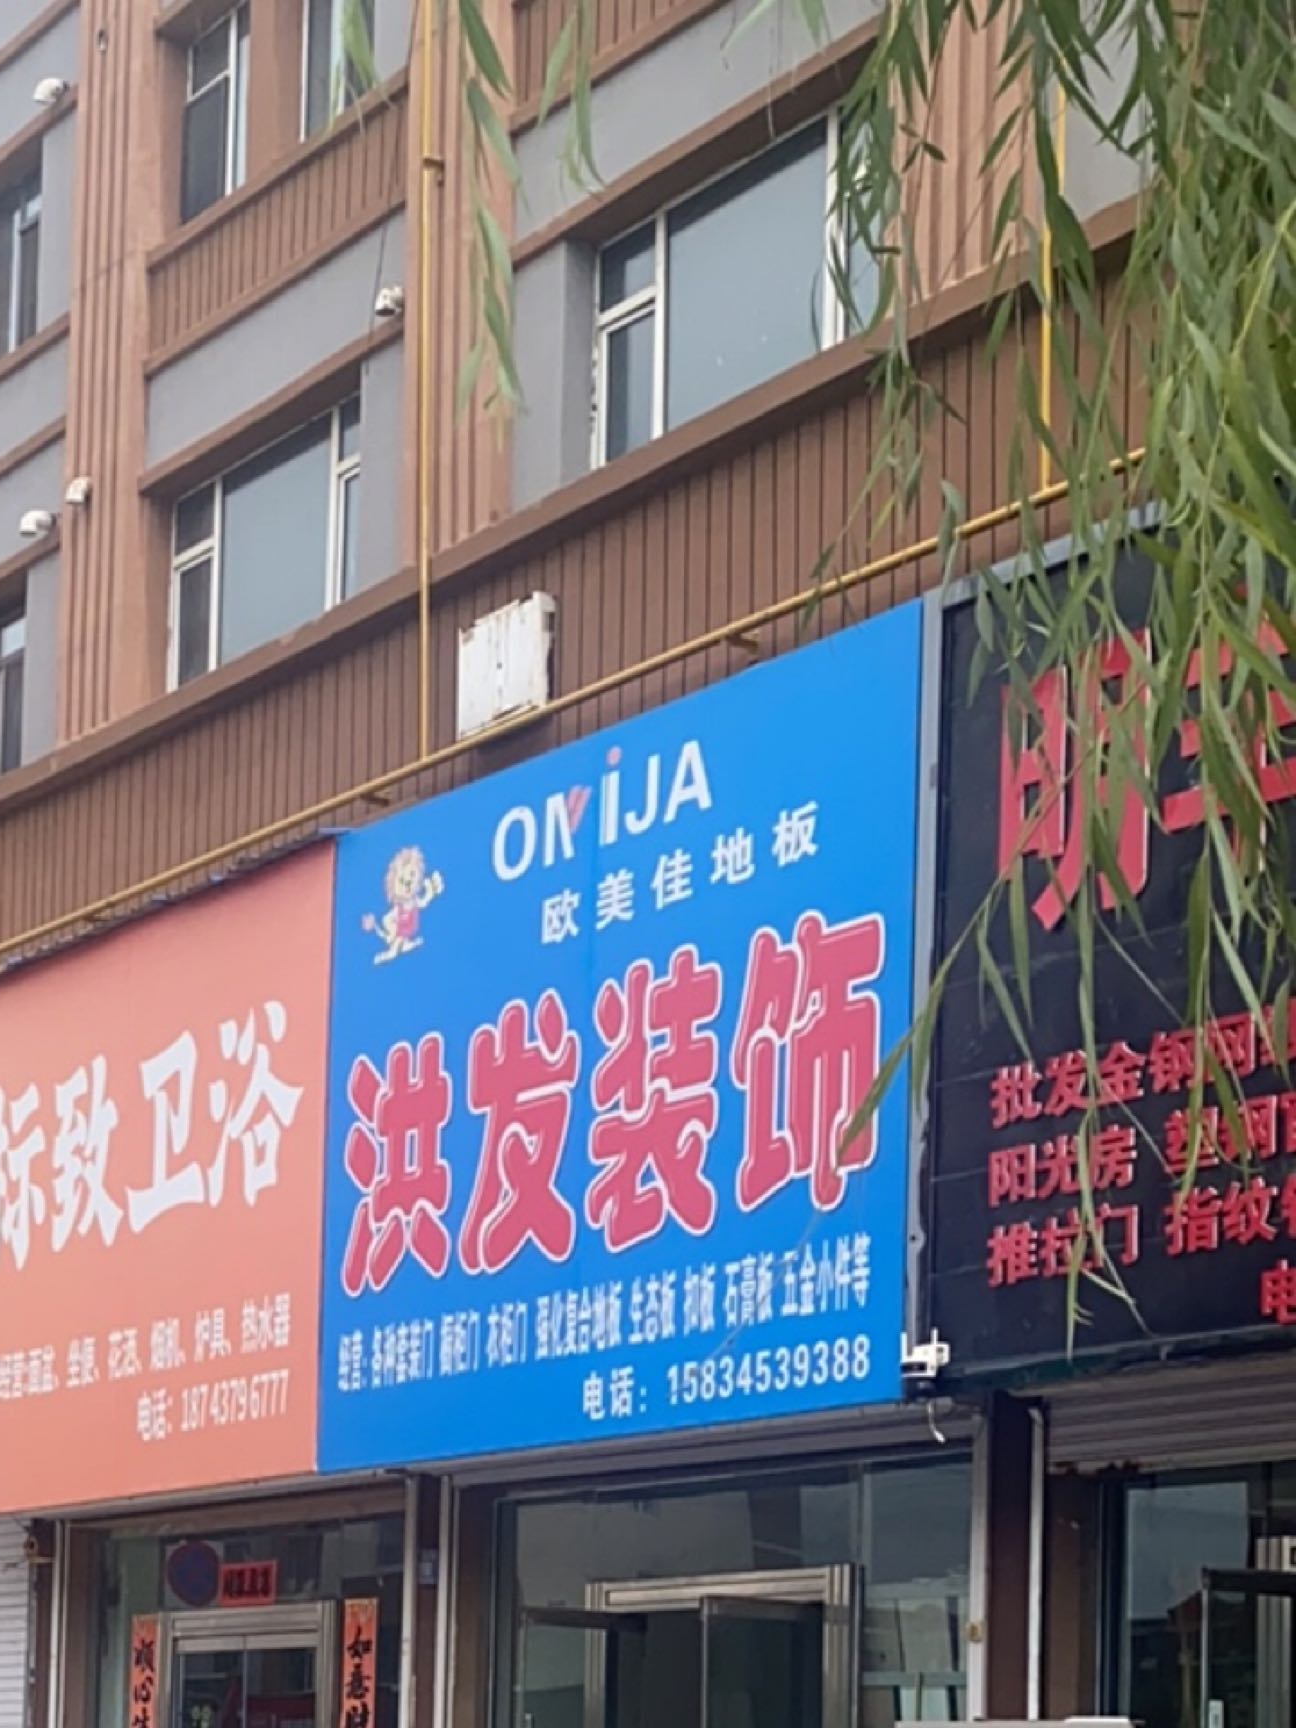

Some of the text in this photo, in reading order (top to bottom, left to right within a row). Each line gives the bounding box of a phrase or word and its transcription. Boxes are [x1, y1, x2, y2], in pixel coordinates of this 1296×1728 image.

[541, 800, 820, 946] 欧美佳地板
[340, 907, 886, 1297] 洪发装饰
[987, 1090, 1296, 1208] 阳光房 塑钢
[986, 1202, 1140, 1288] 推拉门
